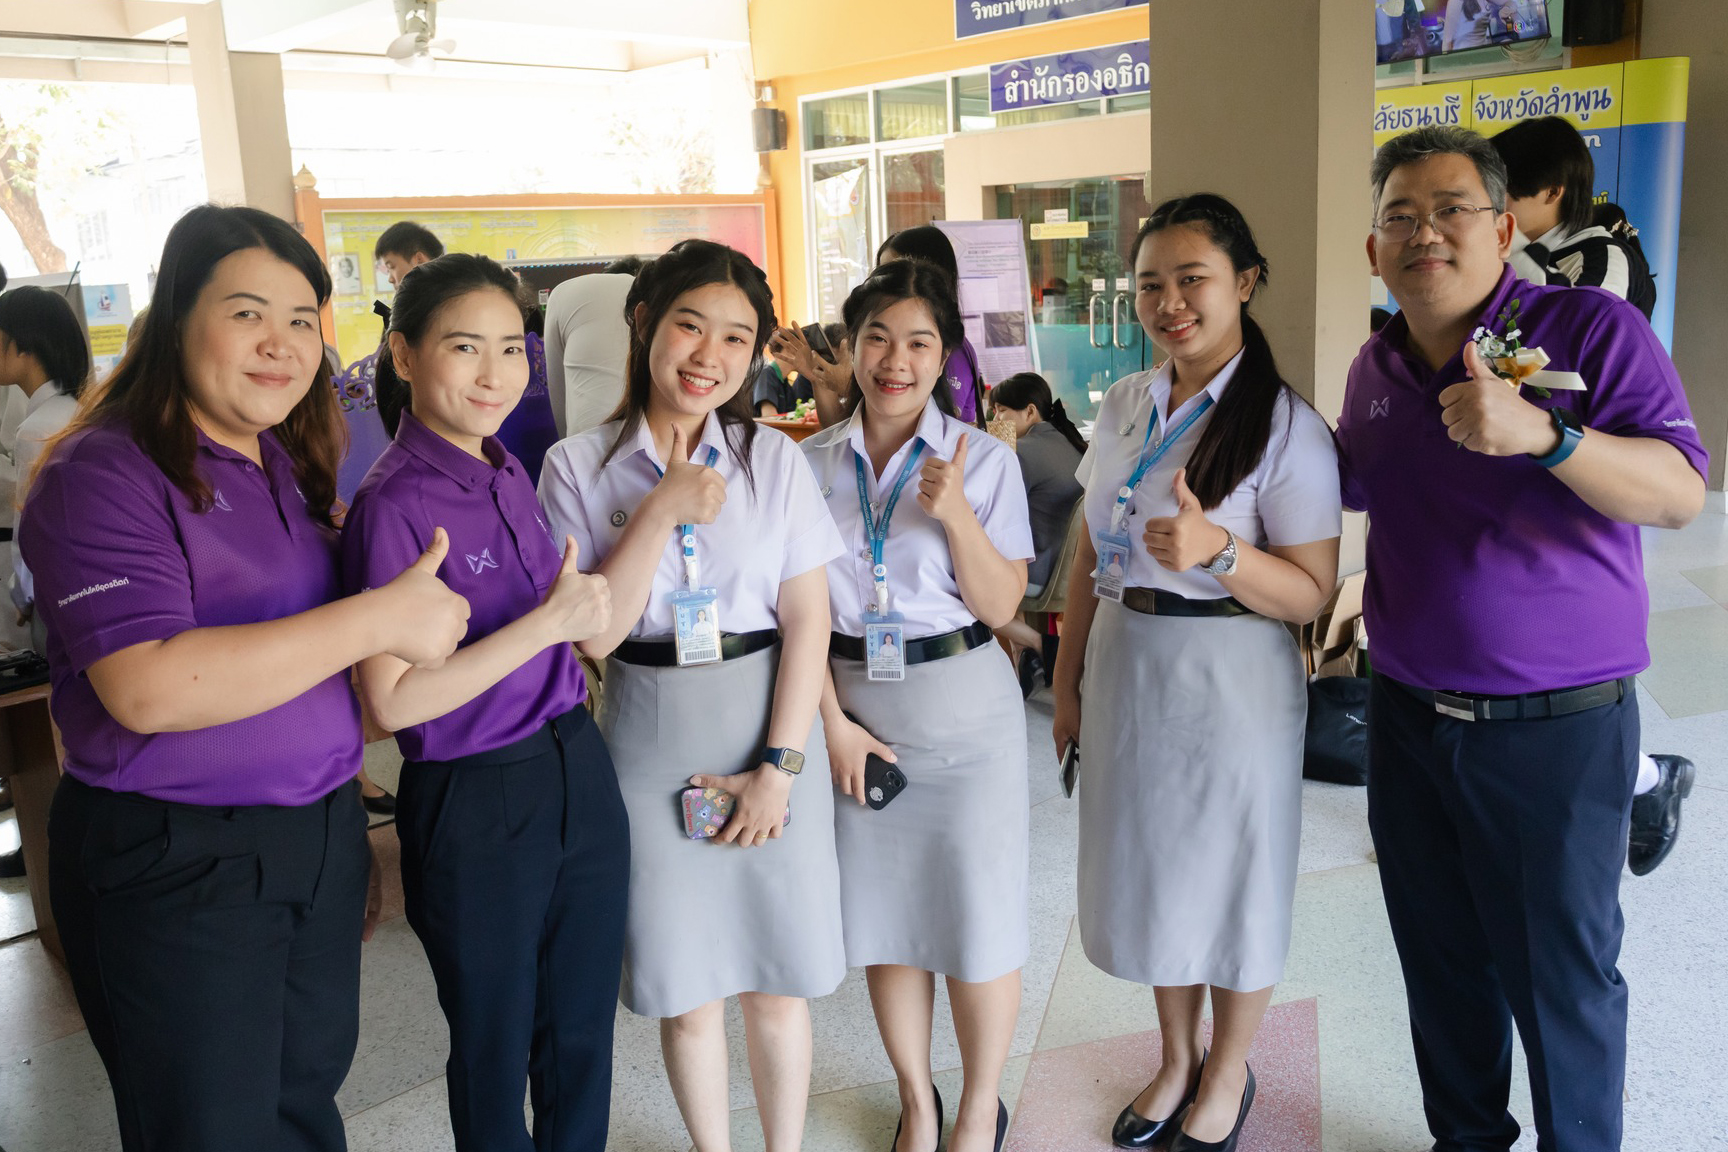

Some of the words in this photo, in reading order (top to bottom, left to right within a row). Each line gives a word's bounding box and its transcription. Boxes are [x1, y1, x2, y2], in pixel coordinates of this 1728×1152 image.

[1374, 95, 1461, 131] ลัยธนบรี
[1474, 86, 1613, 121] จังหวัดลำพูน
